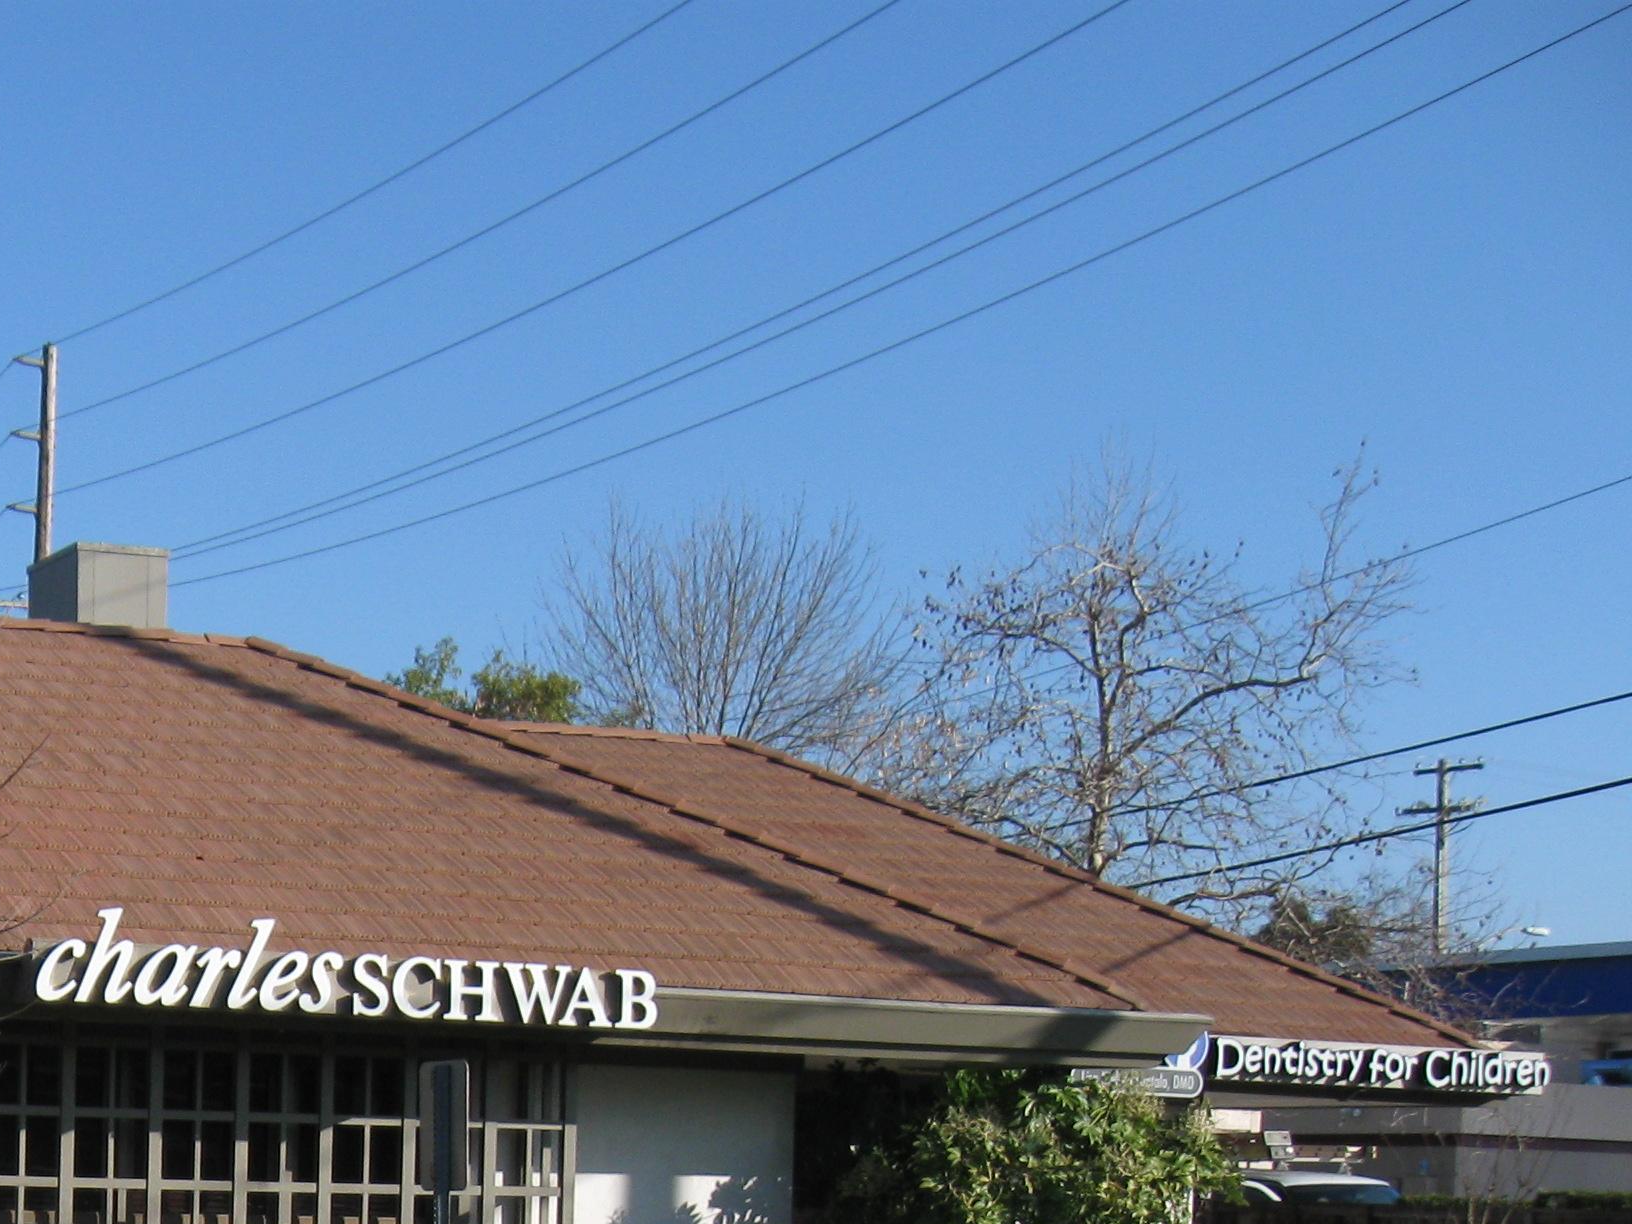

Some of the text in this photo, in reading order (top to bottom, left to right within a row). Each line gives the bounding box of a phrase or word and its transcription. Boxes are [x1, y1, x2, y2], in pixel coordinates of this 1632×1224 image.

[36, 908, 658, 1029] charles SCHWAB
[1217, 1038, 1550, 1088] Dentistry for Children
